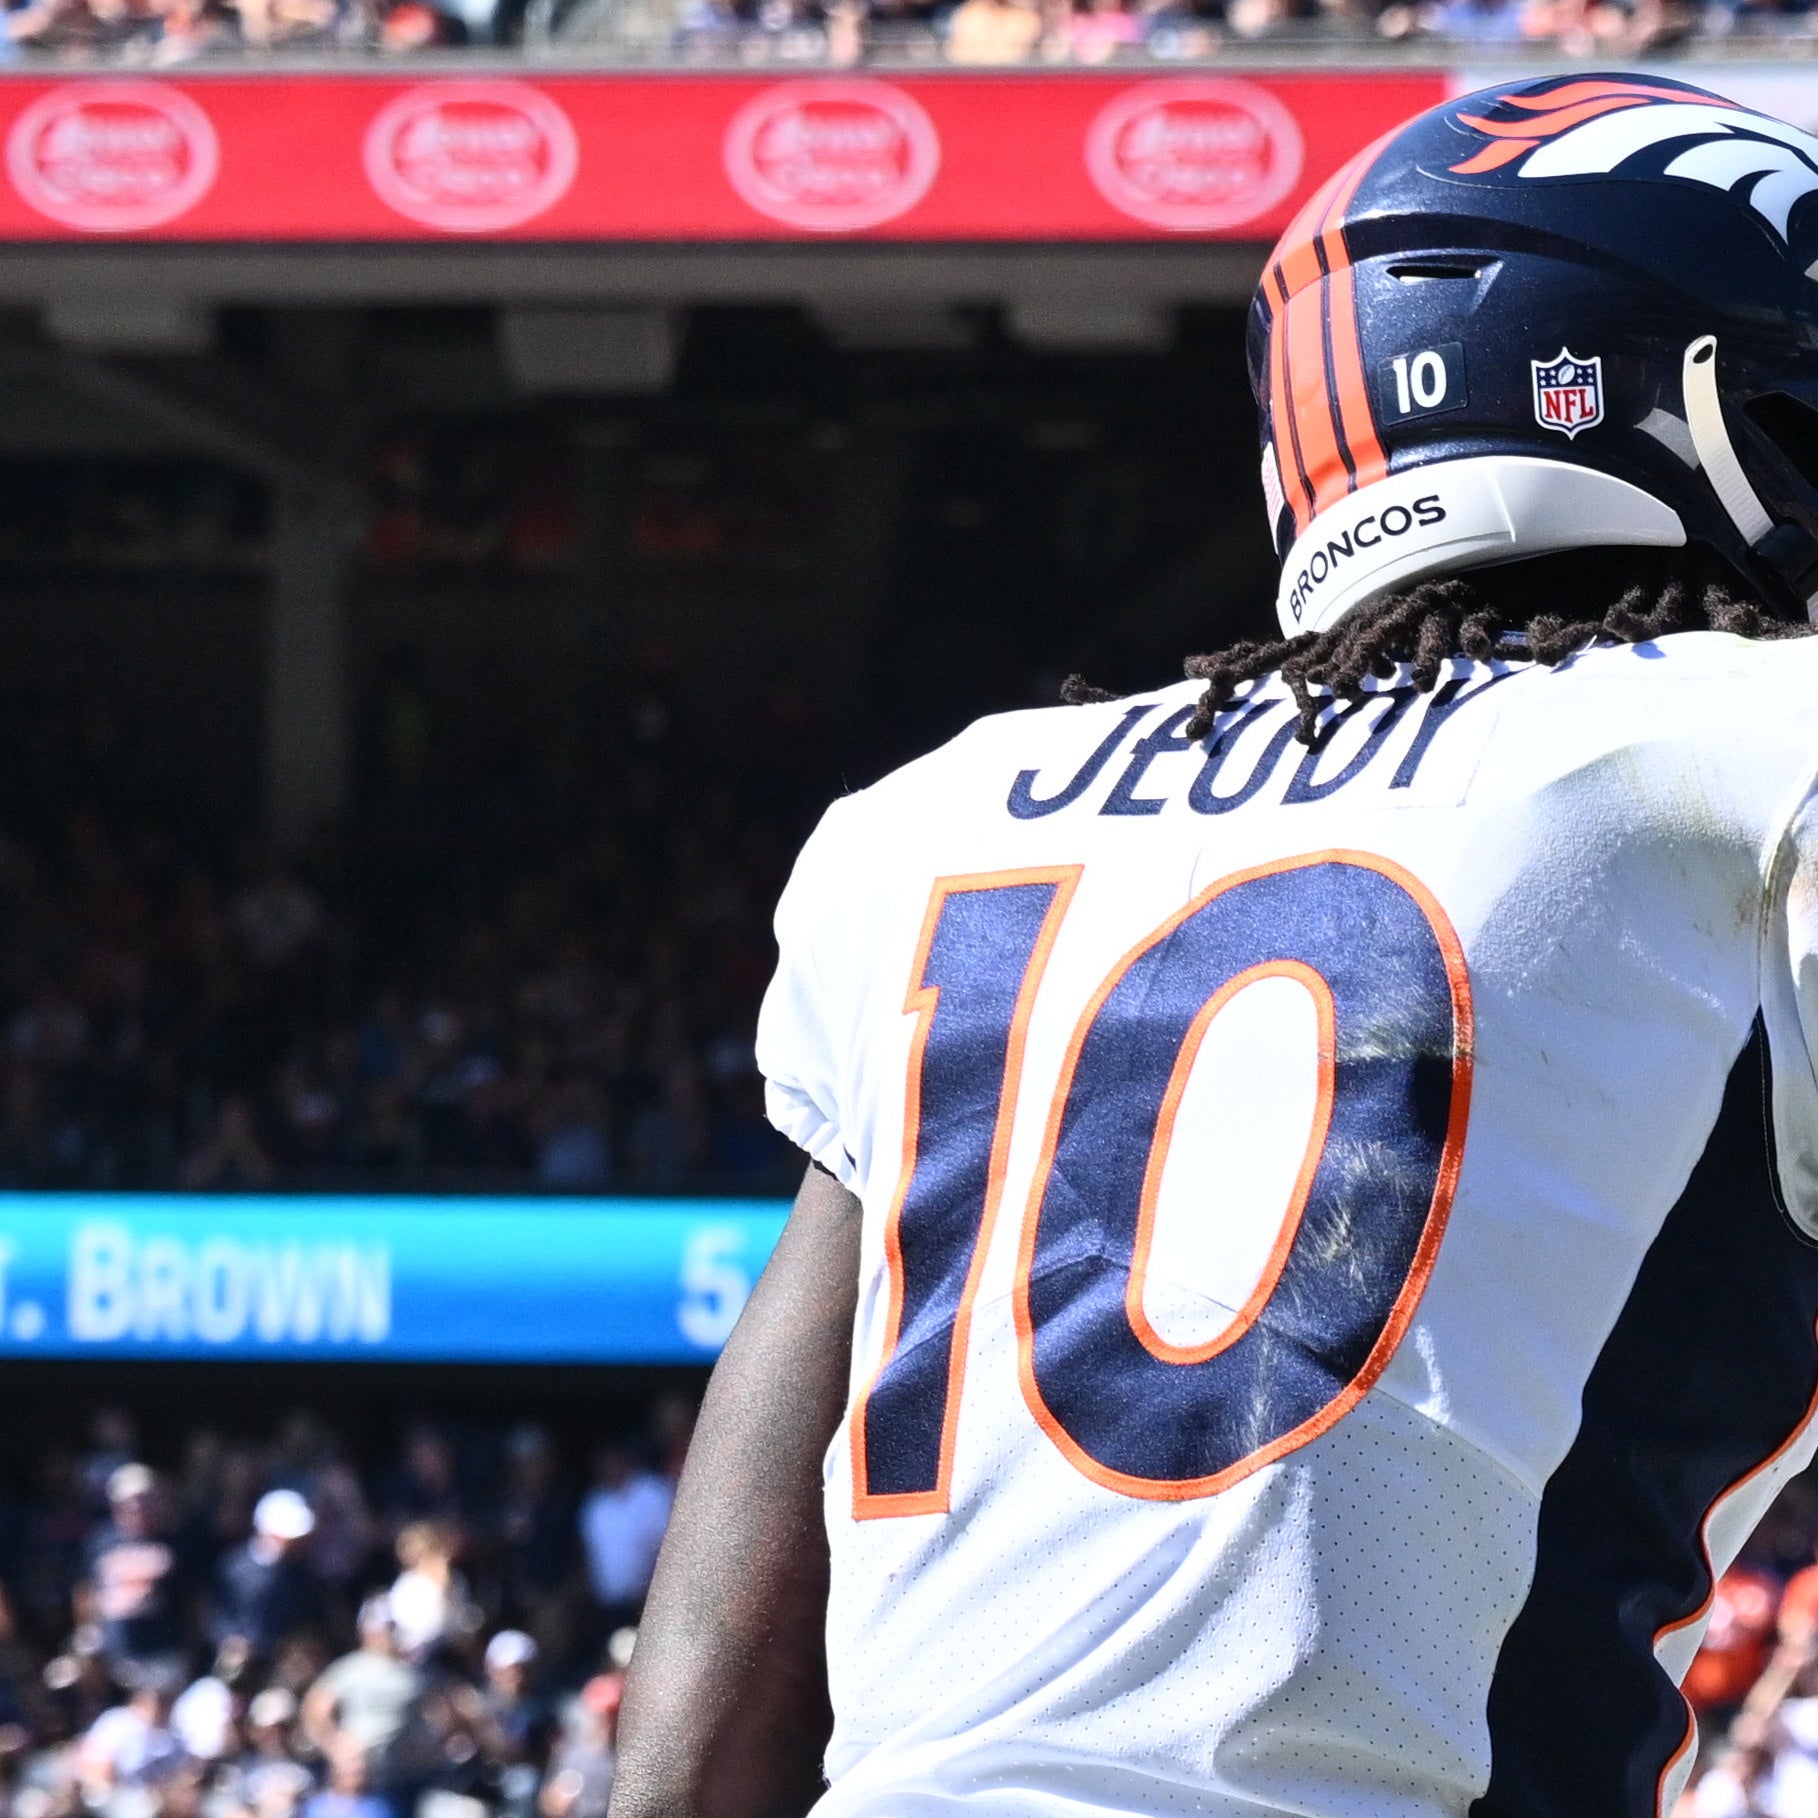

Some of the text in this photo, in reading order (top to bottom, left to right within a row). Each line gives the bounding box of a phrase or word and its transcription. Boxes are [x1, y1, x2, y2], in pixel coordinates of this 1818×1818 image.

[1393, 350, 1447, 414] 10
[1544, 388, 1595, 424] NFL
[1289, 494, 1447, 624] BRONCOS
[851, 848, 1474, 1521] 10
